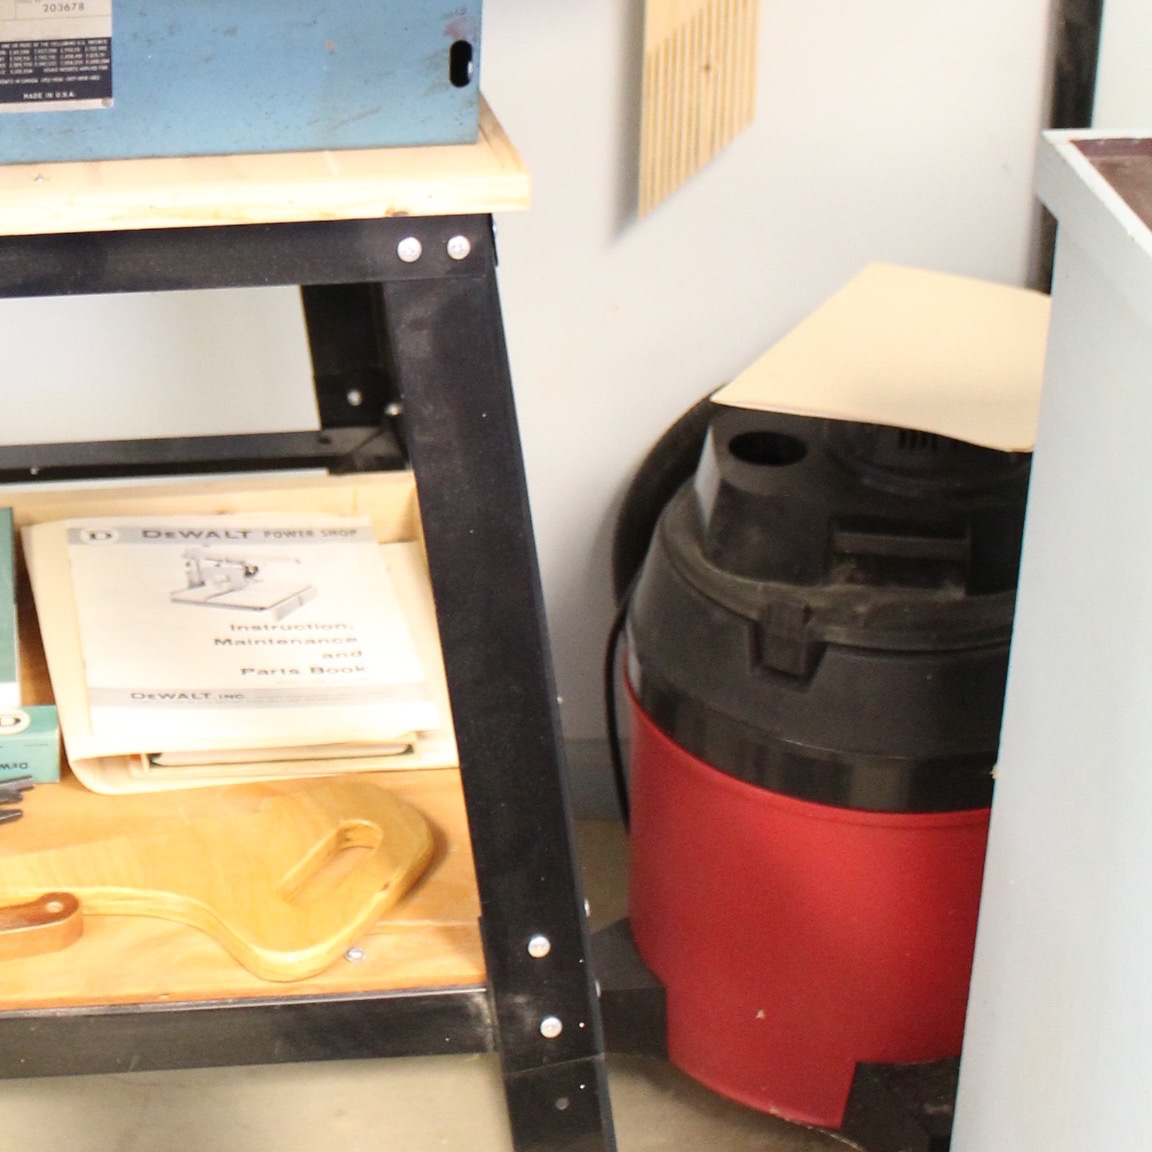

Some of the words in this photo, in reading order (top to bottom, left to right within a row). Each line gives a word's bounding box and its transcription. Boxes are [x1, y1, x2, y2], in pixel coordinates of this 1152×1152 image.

[43, 2, 85, 13] 203678
[22, 92, 43, 101] MADE
[45, 91, 54, 99] IN
[264, 529, 314, 538] POWER
[320, 528, 359, 538] SHOP
[213, 636, 358, 646] Maintenance
[321, 649, 364, 659] and
[240, 667, 301, 676] Parts
[309, 665, 367, 675] Book
